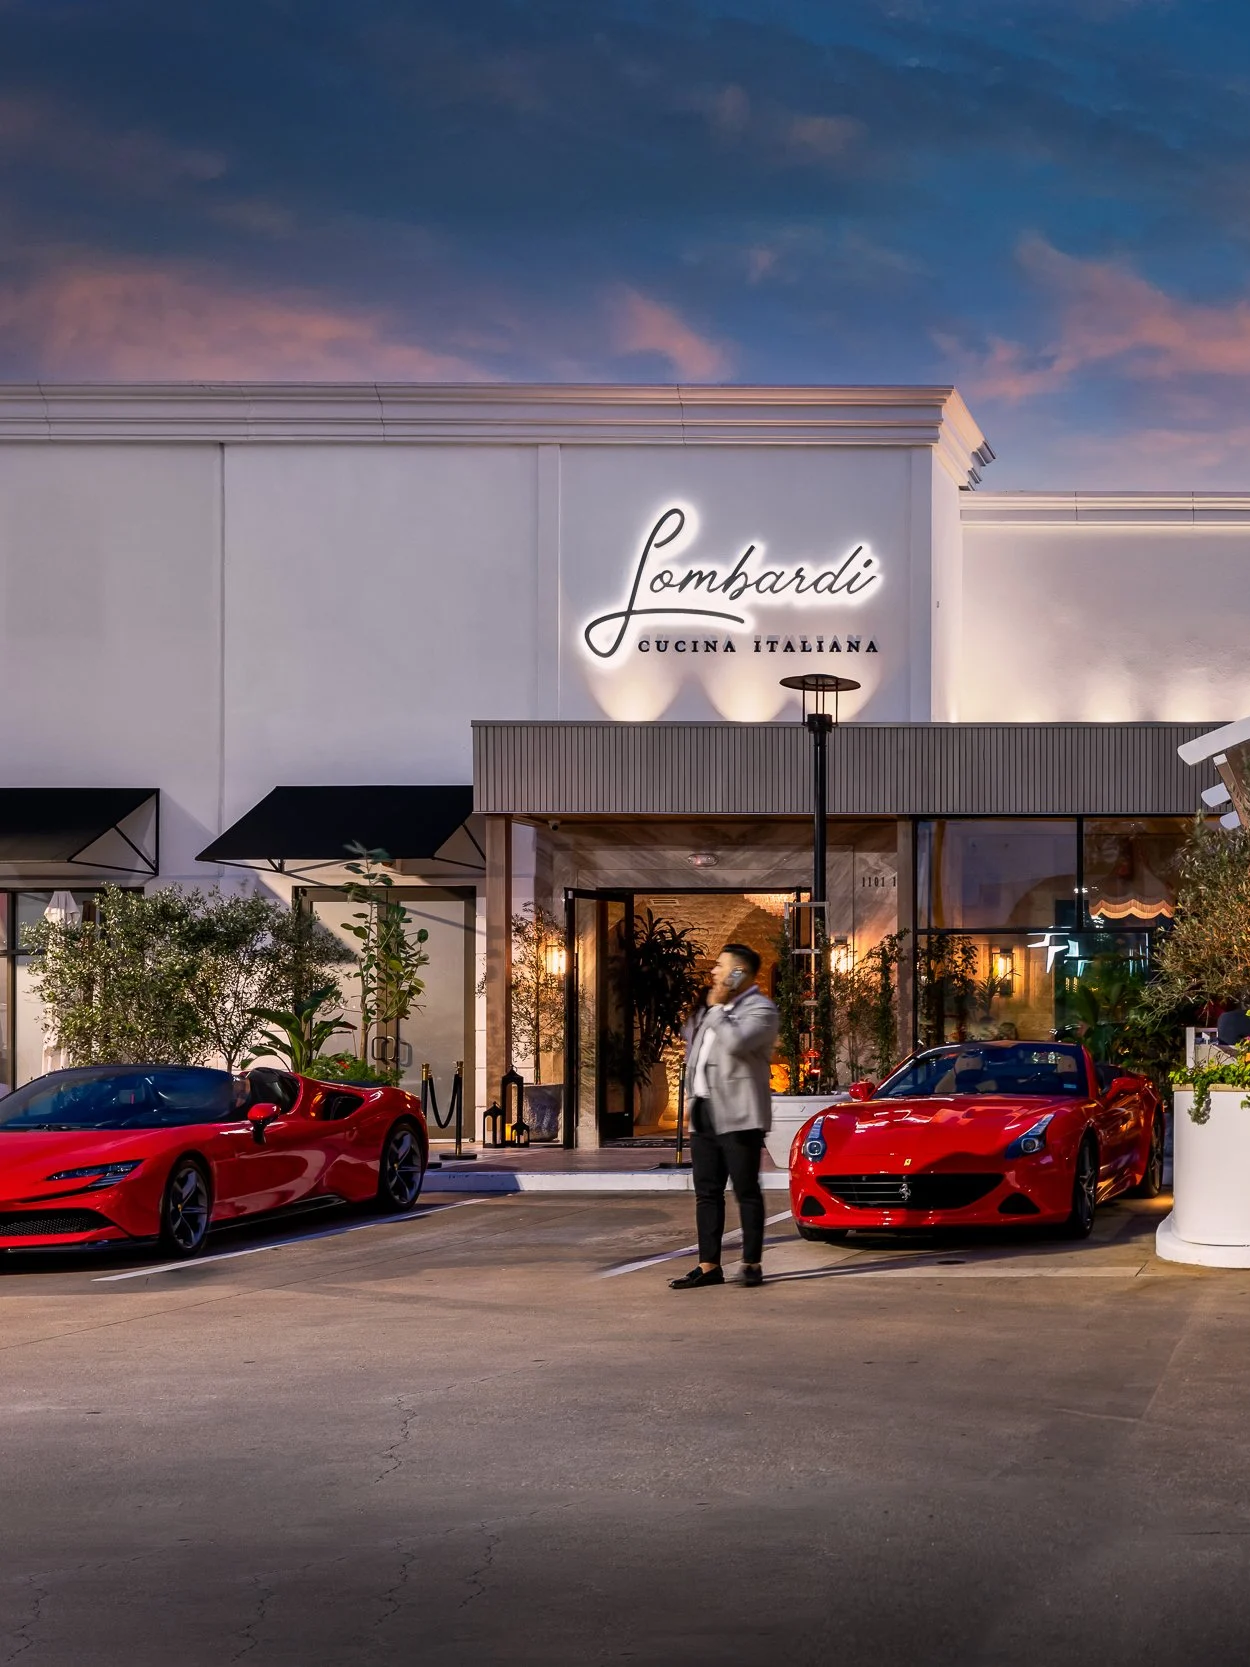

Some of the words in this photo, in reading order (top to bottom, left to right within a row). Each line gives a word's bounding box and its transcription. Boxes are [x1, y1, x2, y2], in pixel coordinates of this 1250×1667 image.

[584, 508, 879, 658] Lombardi
[638, 640, 736, 653] CUCINA
[753, 640, 879, 653] ITALIANA
